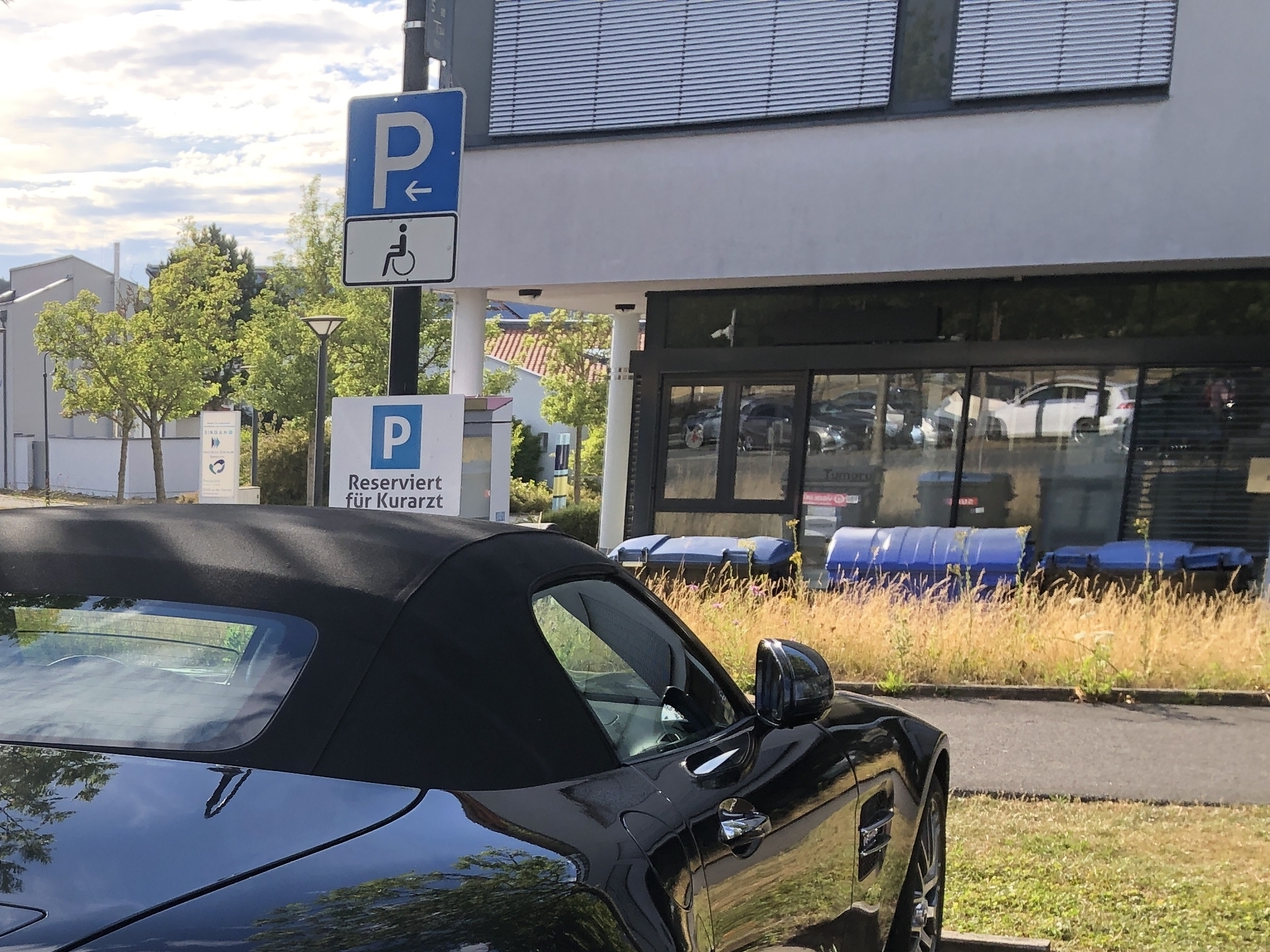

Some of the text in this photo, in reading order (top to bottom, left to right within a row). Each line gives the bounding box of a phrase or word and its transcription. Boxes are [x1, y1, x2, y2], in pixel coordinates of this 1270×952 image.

[373, 111, 433, 209] P
[383, 416, 411, 459] P
[348, 474, 443, 491] Reserviert
[346, 491, 444, 509] für Kurarzt
